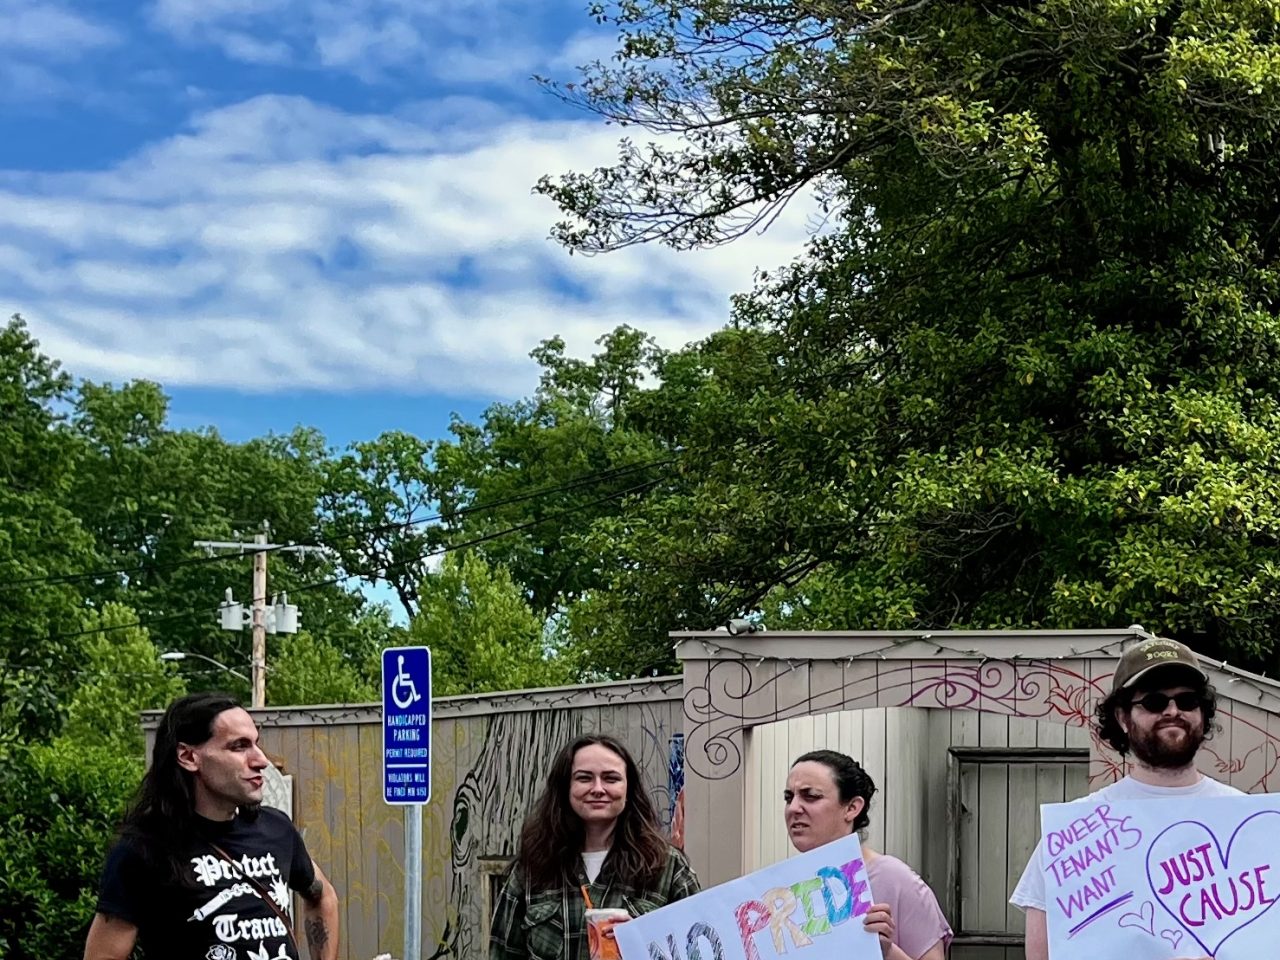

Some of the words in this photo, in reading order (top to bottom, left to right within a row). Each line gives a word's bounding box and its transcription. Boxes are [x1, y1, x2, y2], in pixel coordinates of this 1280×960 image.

[387, 714, 426, 726] HANDICAPPED
[393, 729, 420, 741] PARKING
[1046, 816, 1142, 887] TENANTS
[1047, 804, 1122, 857] QUEER
[1056, 865, 1116, 919] WANT
[1158, 843, 1215, 894] JUST
[1180, 865, 1274, 926] CAUSE
[212, 913, 288, 942] Trans
